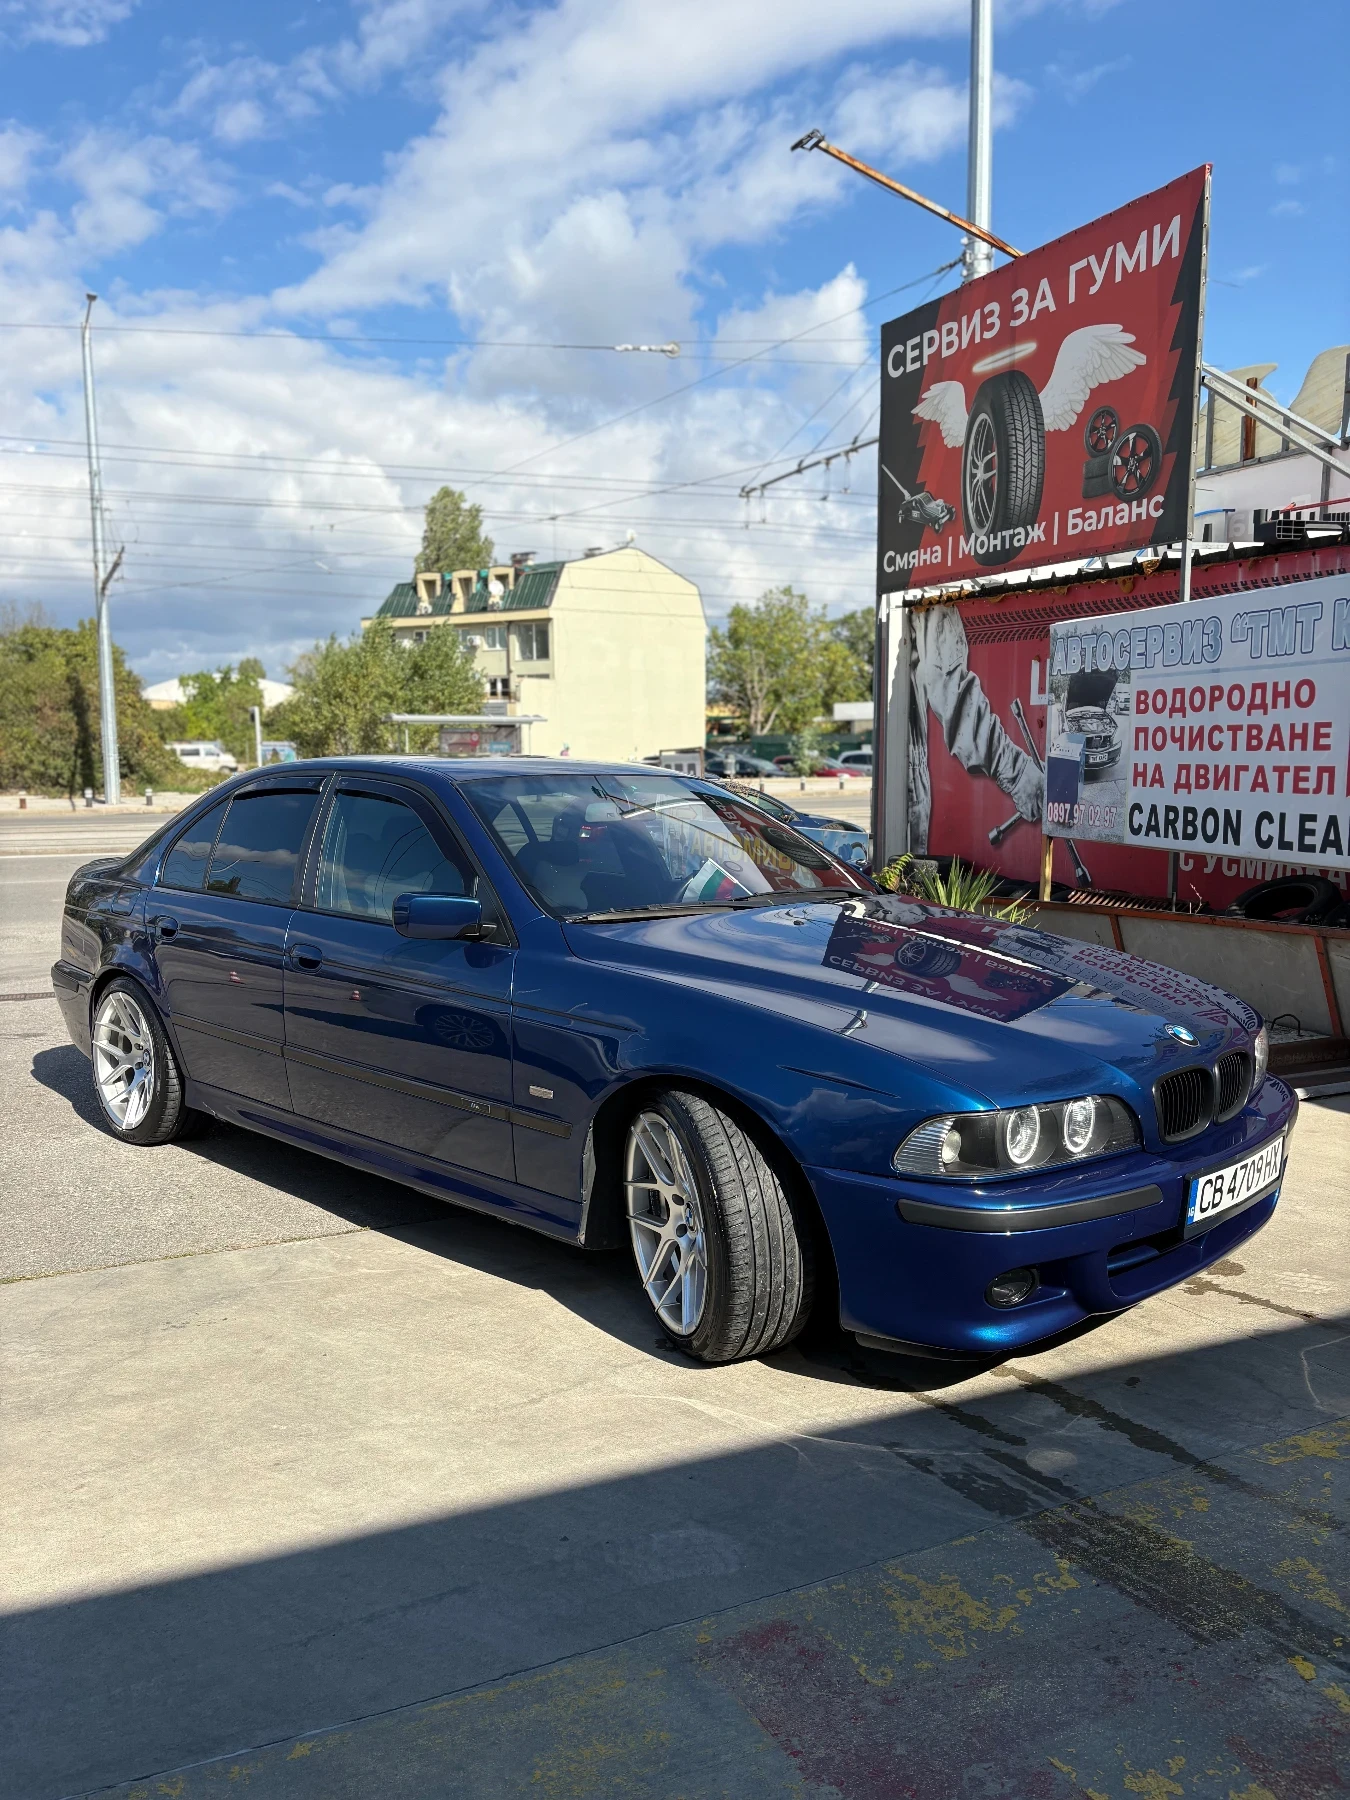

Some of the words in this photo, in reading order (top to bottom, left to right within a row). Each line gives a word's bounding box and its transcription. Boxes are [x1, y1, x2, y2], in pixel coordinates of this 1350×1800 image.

[887, 302, 1000, 378] СЕРВИЗ
[1010, 277, 1056, 327] ЗА
[1068, 214, 1181, 304] ГУМИ
[883, 545, 942, 573] Смяна
[959, 520, 1046, 558] Монтаж
[1067, 495, 1165, 535] Баланс
[1051, 616, 1222, 676] АВТОСЕРВИЗ
[1135, 678, 1316, 719] ВОДОРОДНО
[1134, 721, 1333, 752] ПОЧИСТВАНЕ
[1132, 763, 1165, 789] НА
[1173, 763, 1336, 796] ДВИГАТЕЛ
[1047, 802, 1070, 823] 0897
[1128, 802, 1242, 847] CARBON
[1254, 810, 1350, 857] CLEA
